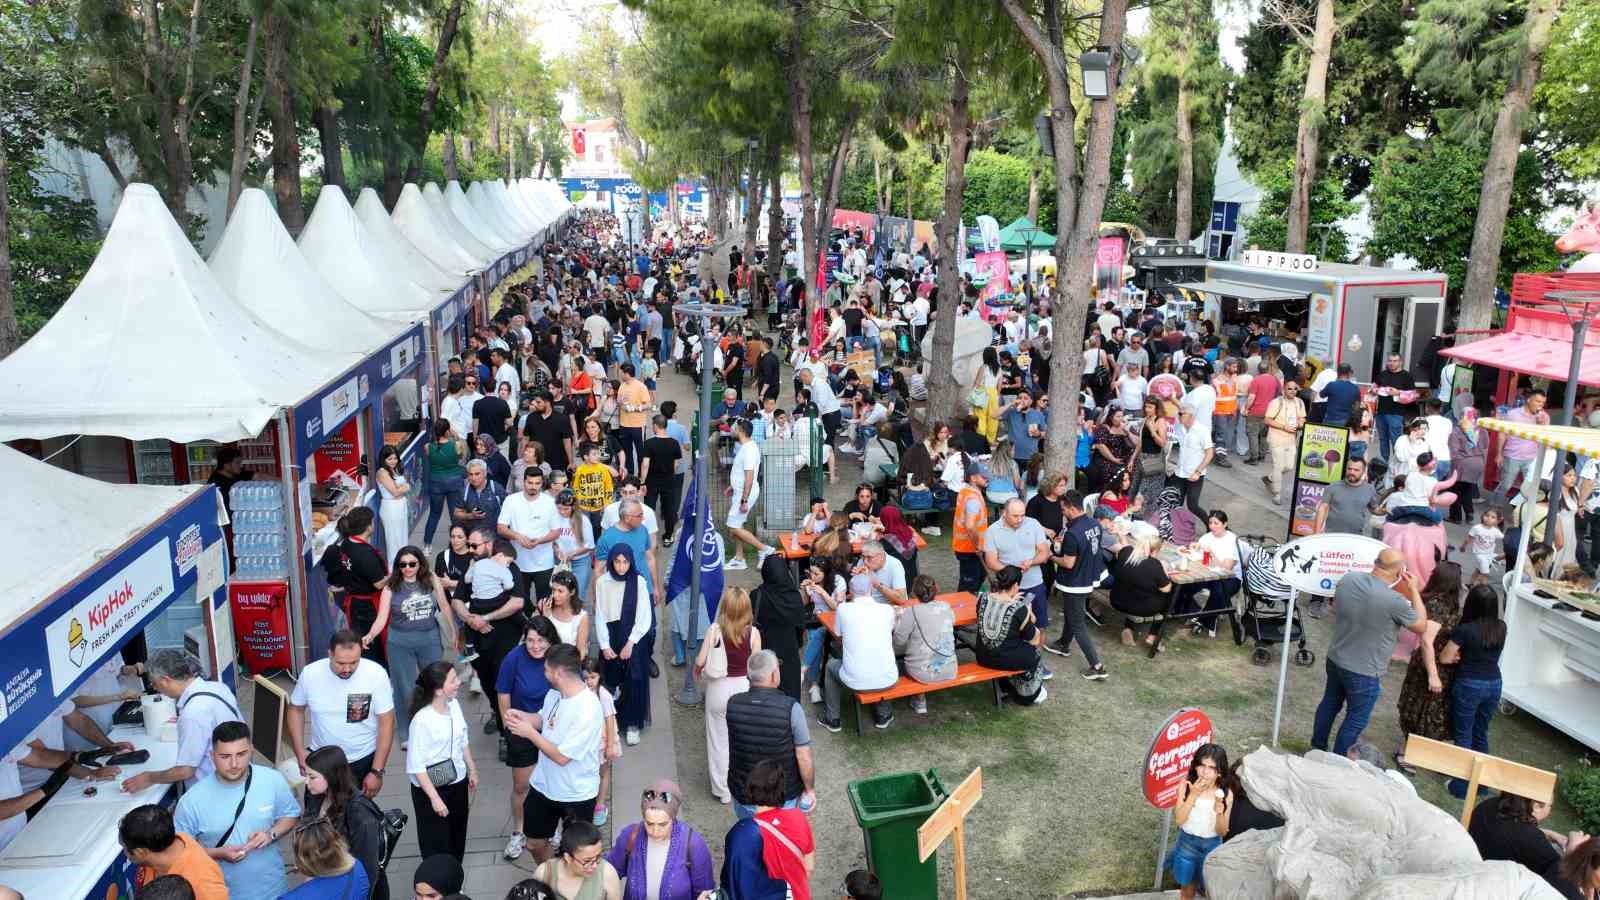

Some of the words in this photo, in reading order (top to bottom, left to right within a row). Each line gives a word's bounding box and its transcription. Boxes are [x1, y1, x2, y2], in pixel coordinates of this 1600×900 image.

[1302, 485, 1325, 497] TAH
[1319, 551, 1355, 560] Lütfen!
[88, 579, 134, 631] KipHok
[91, 630, 110, 650] FRESH
[111, 618, 124, 634] AND
[123, 602, 141, 623] TASTY
[140, 584, 163, 609] CHICKEN
[6, 667, 30, 692] ANTALYA
